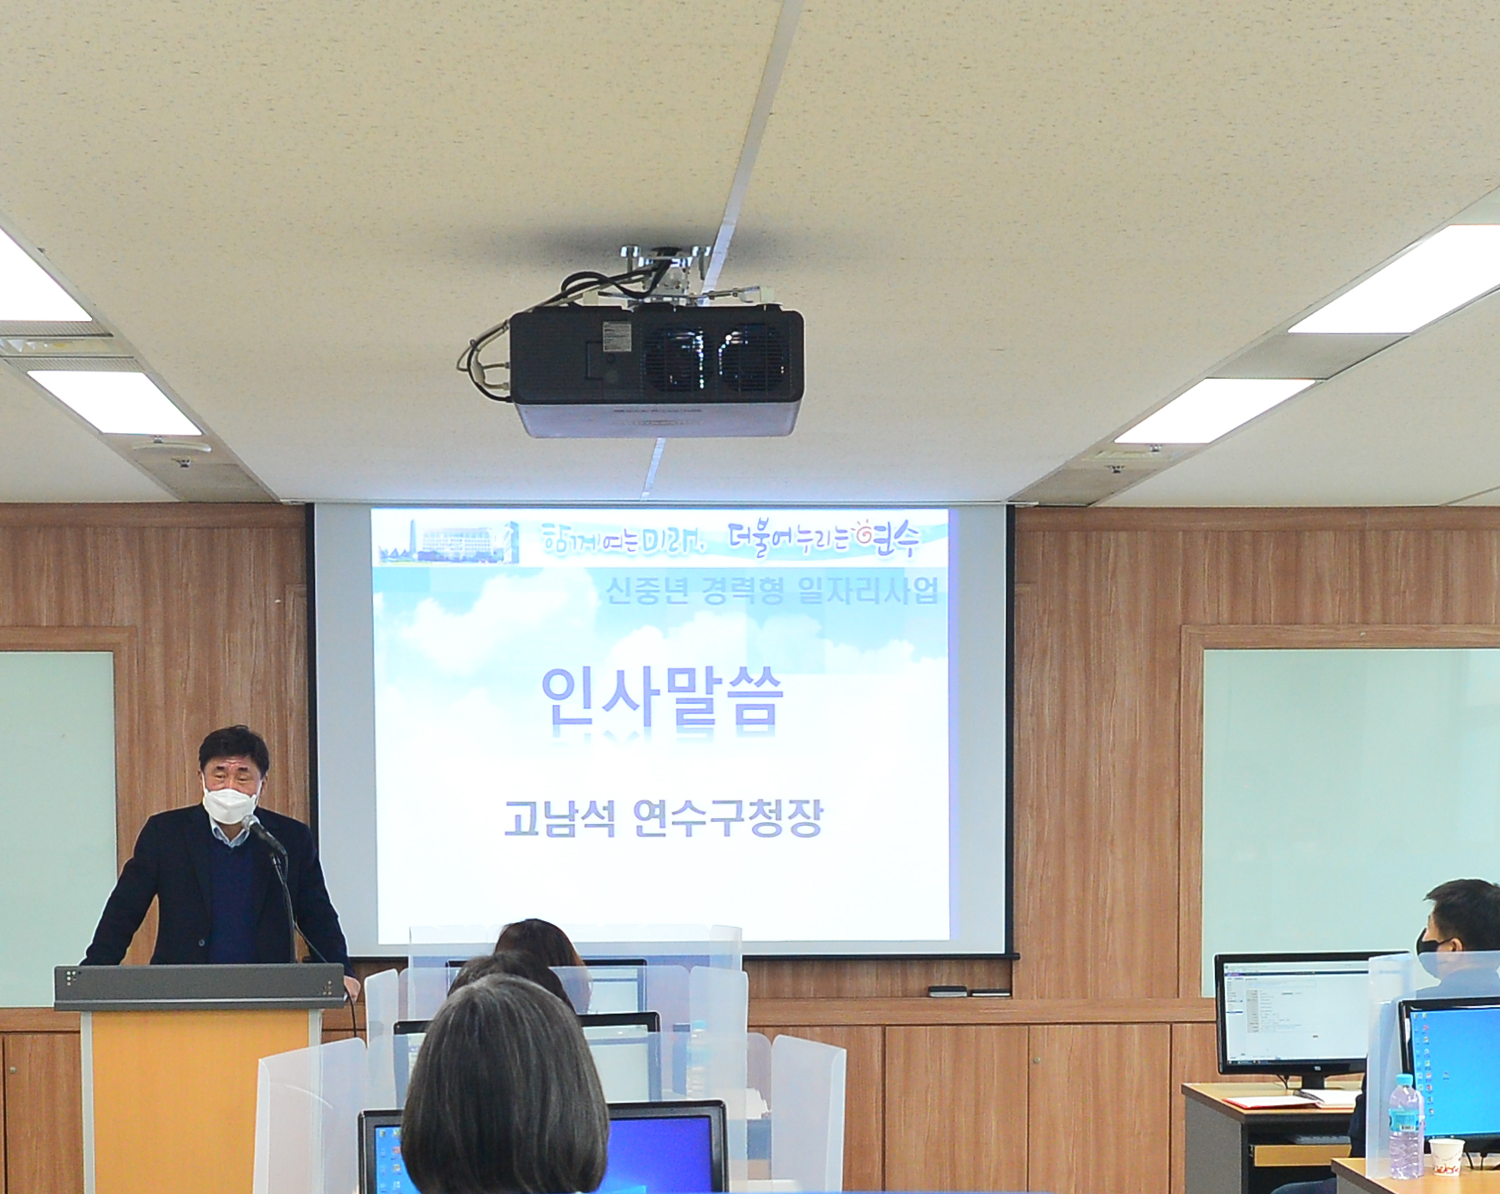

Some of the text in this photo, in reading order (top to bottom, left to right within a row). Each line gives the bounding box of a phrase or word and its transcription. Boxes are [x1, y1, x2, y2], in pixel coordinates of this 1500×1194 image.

[605, 575, 940, 606] 신중년 경력형 일자리사업
[541, 664, 784, 728] 인사말씀
[504, 797, 825, 839] 고남석 연수구청장
